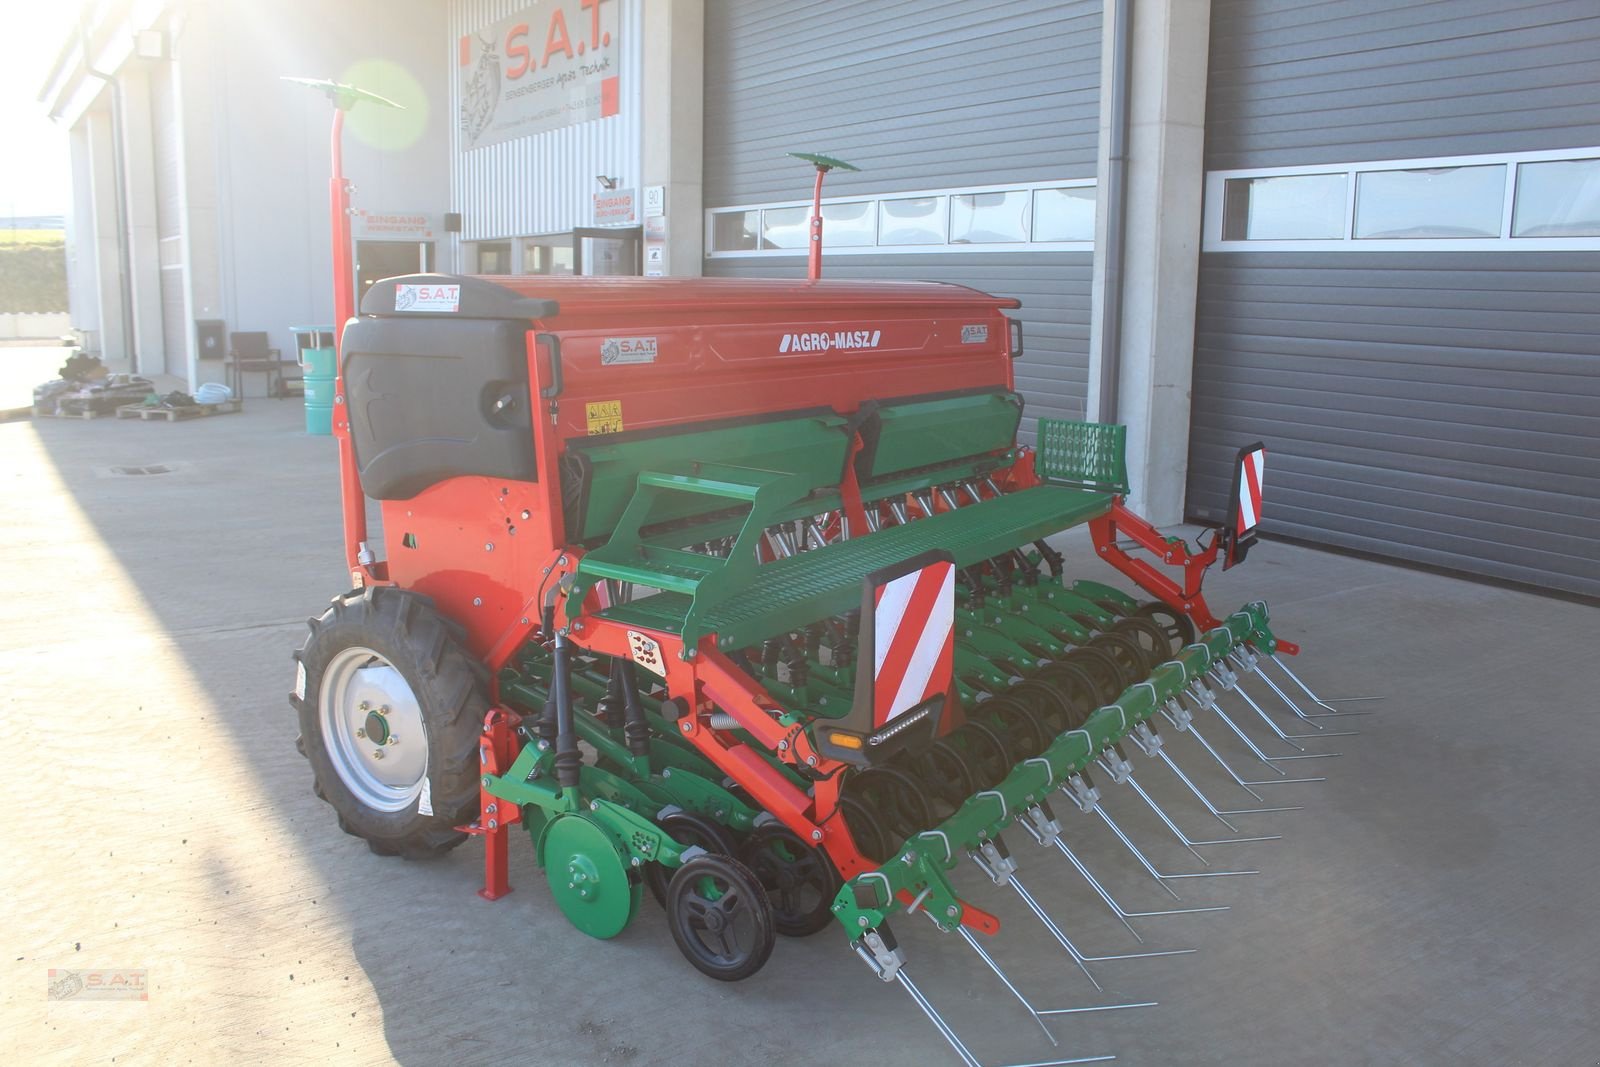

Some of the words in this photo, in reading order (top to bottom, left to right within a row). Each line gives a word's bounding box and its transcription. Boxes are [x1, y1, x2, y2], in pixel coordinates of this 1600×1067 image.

[504, 0, 611, 80] S.A.T.
[595, 196, 631, 209] EINGANG
[367, 215, 426, 225] EINGANG
[620, 340, 656, 352] S.A.T.
[790, 330, 872, 352] AGRO-MASZ
